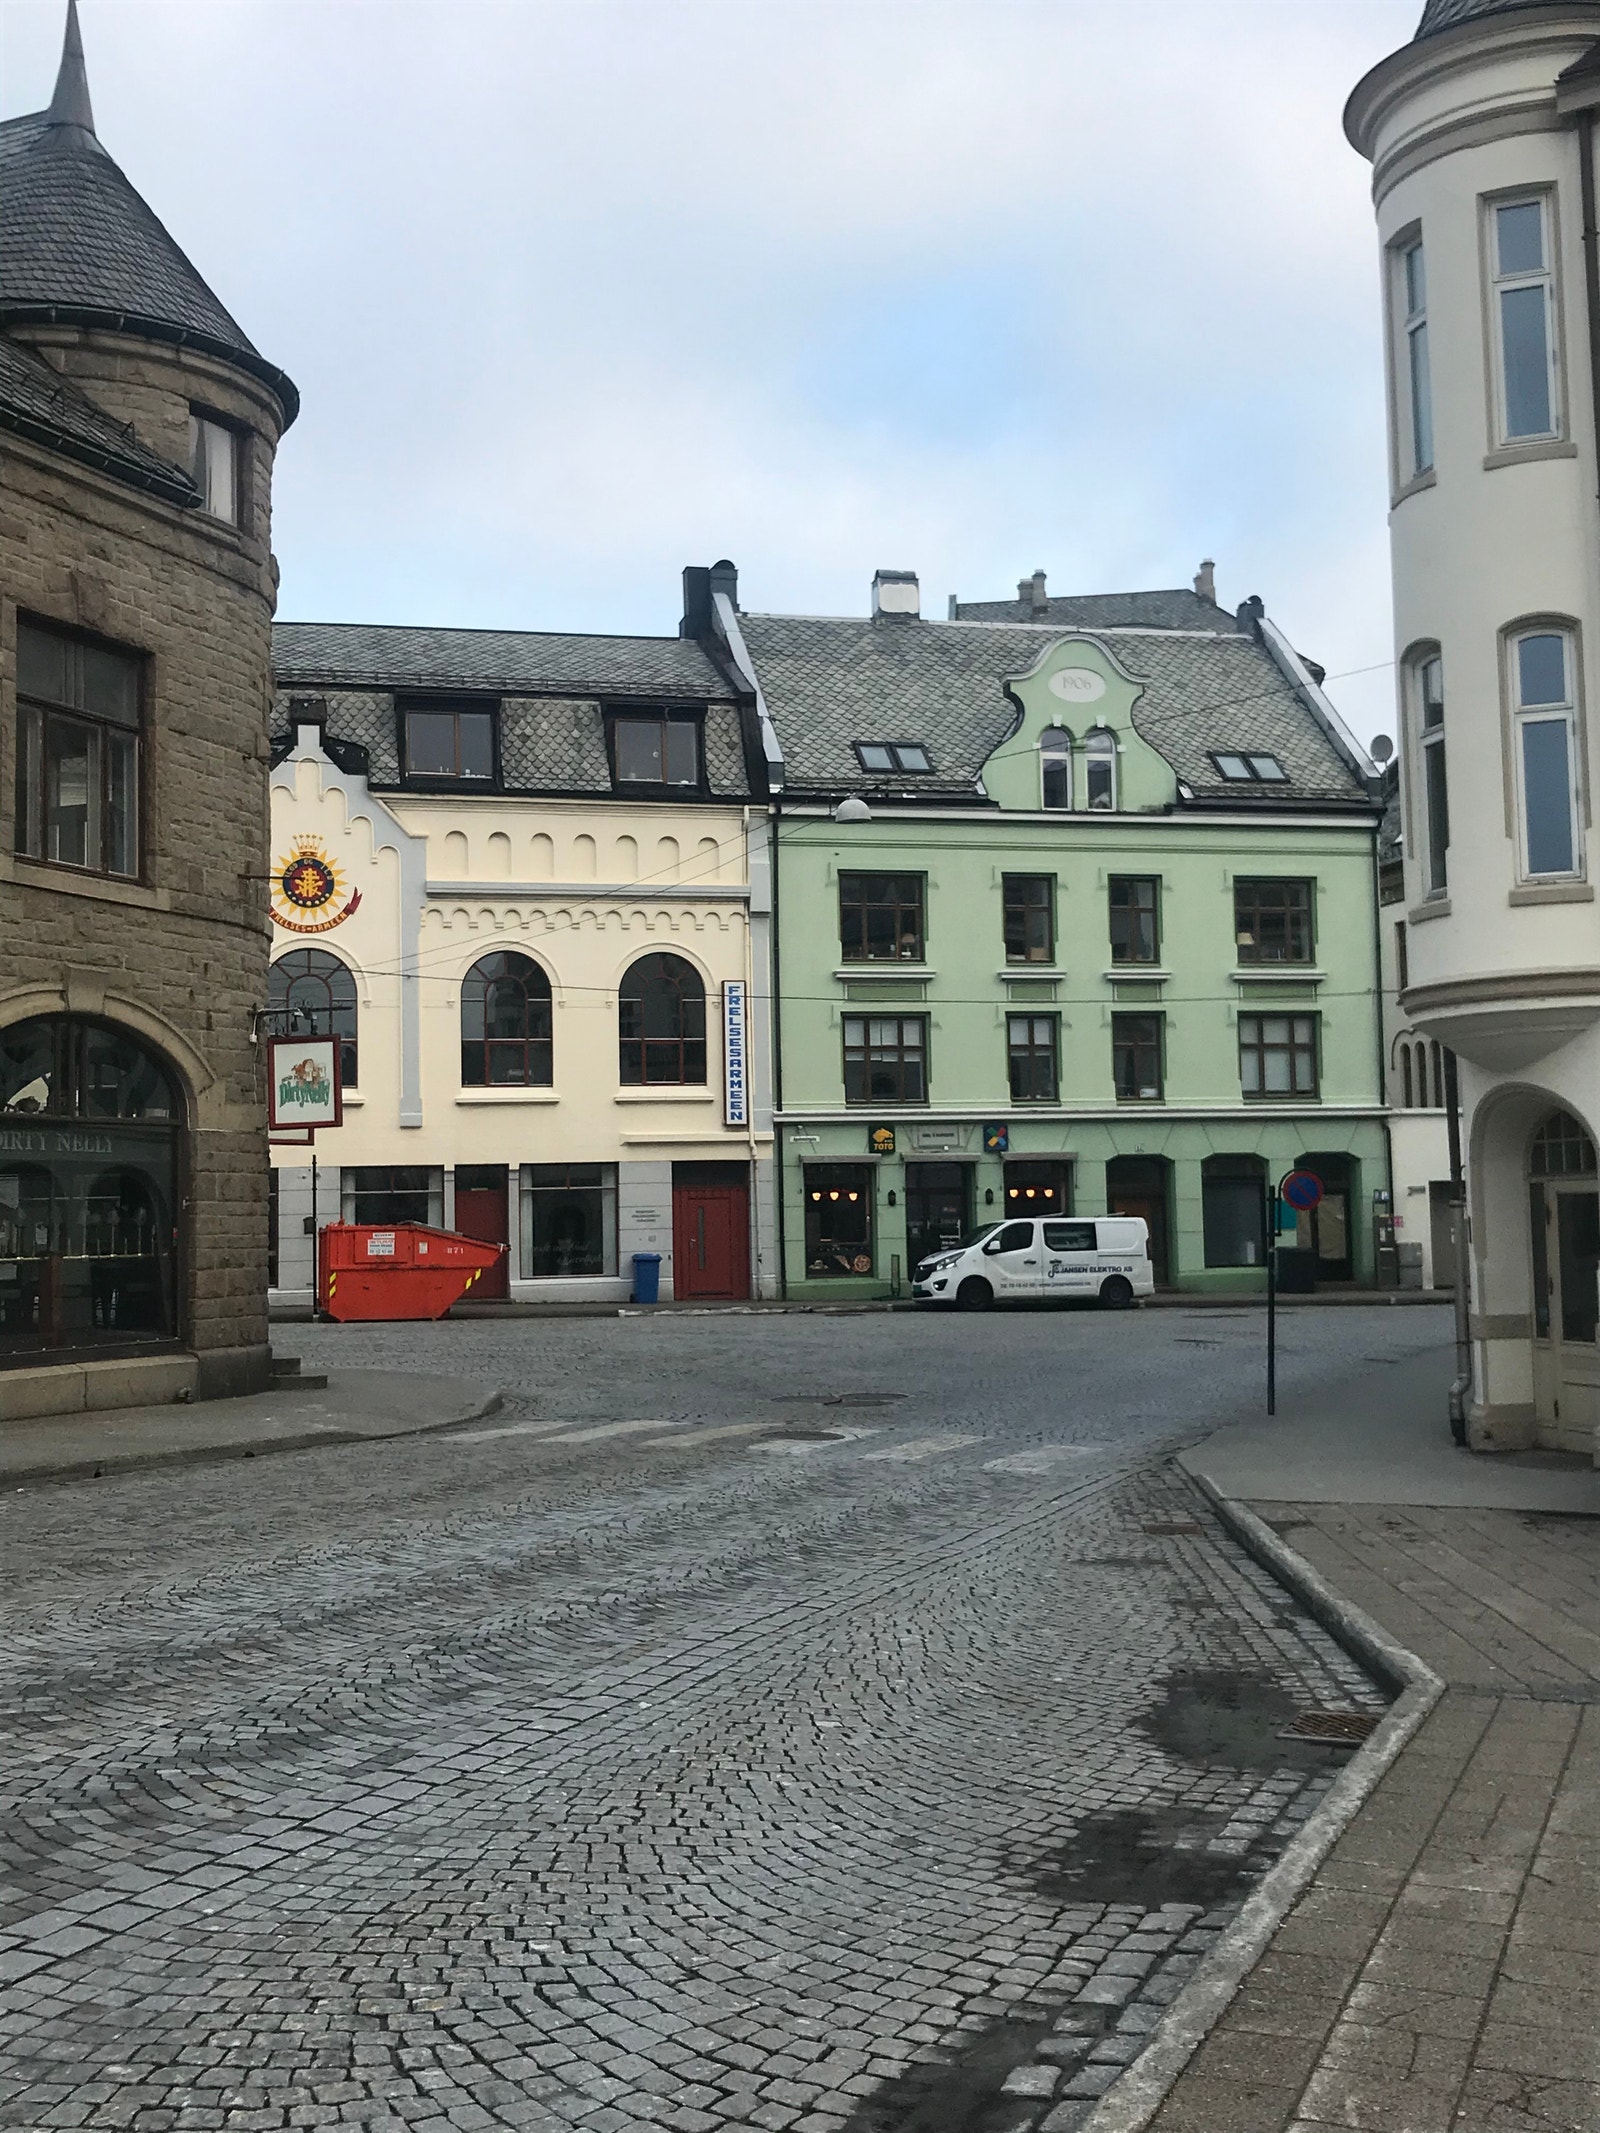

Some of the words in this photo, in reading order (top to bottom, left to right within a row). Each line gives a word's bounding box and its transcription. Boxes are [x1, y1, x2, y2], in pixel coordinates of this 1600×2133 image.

[728, 985, 743, 1121] FRELSESARMEEN
[56, 1132, 113, 1153] NELLY
[1089, 1265, 1122, 1273] ELEKTRO
